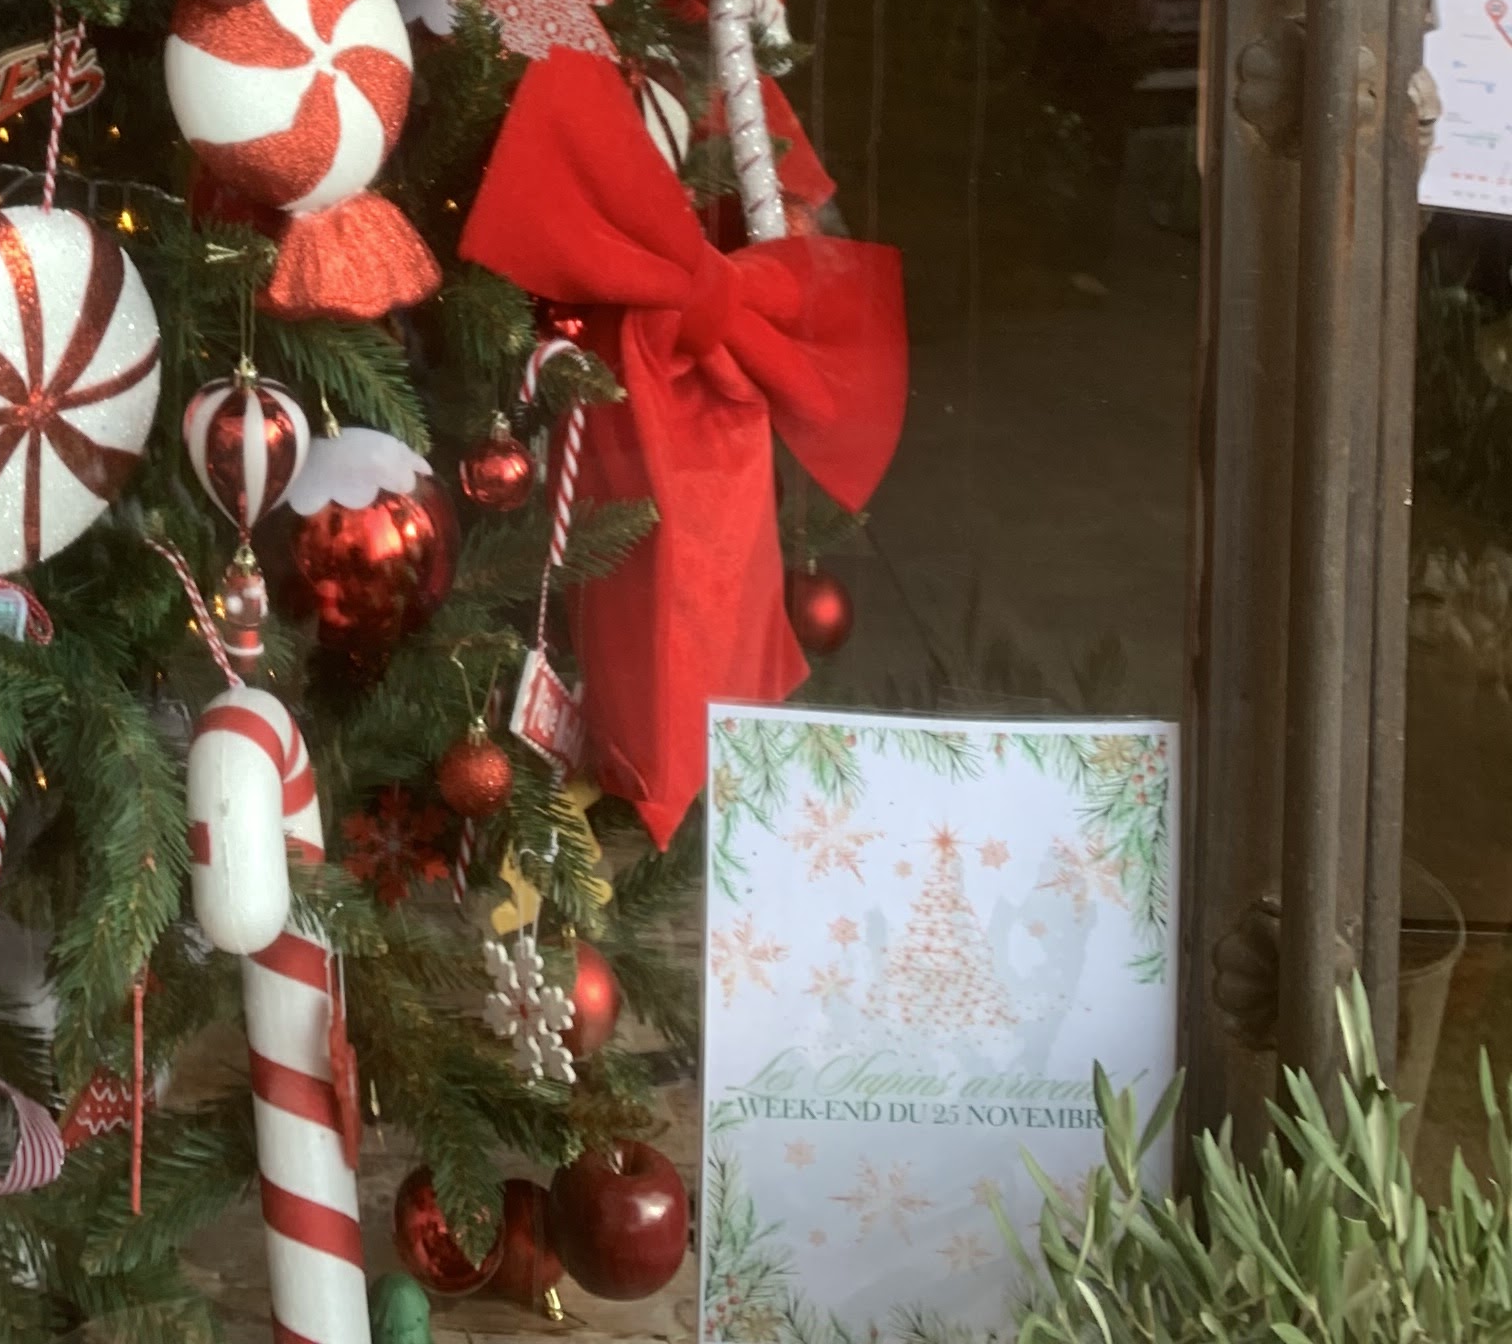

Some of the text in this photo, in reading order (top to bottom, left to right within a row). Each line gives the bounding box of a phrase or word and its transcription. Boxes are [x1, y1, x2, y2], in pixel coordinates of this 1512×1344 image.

[960, 1070, 1119, 1101] arriven
[738, 1097, 1107, 1130] WEEK-END DU 25 NOVEMBR
